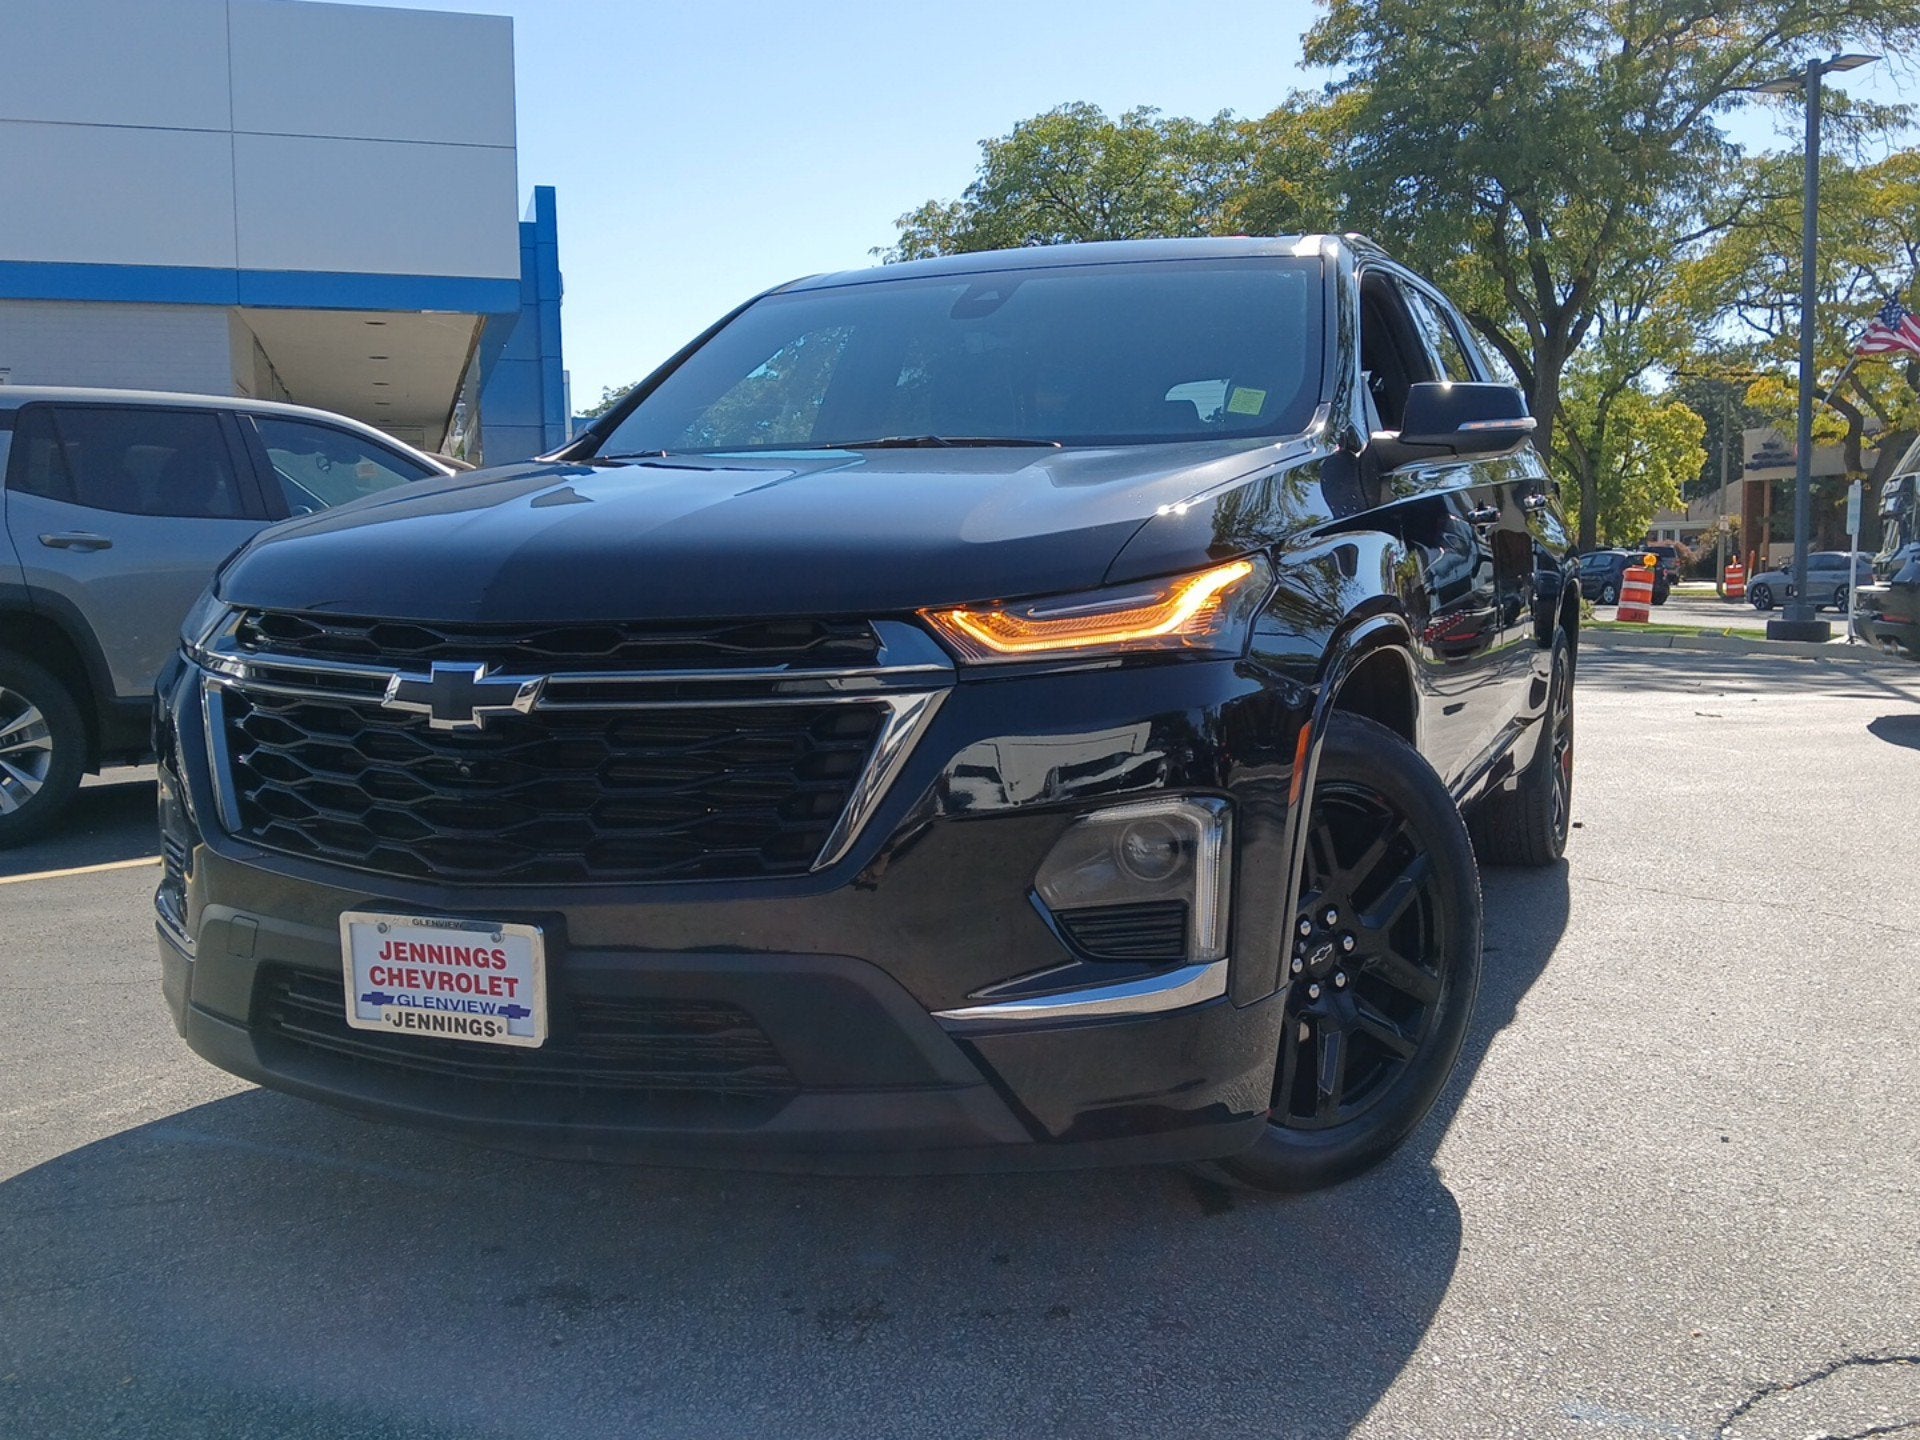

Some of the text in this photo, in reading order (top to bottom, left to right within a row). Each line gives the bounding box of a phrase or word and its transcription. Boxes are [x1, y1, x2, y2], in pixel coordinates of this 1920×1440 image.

[411, 918, 463, 929] GLENVIEW
[379, 941, 506, 969] JENNINGS
[369, 966, 518, 997] CHEVROLET
[397, 994, 496, 1014] GLENVIEW
[393, 1012, 496, 1037] JENNINGS
